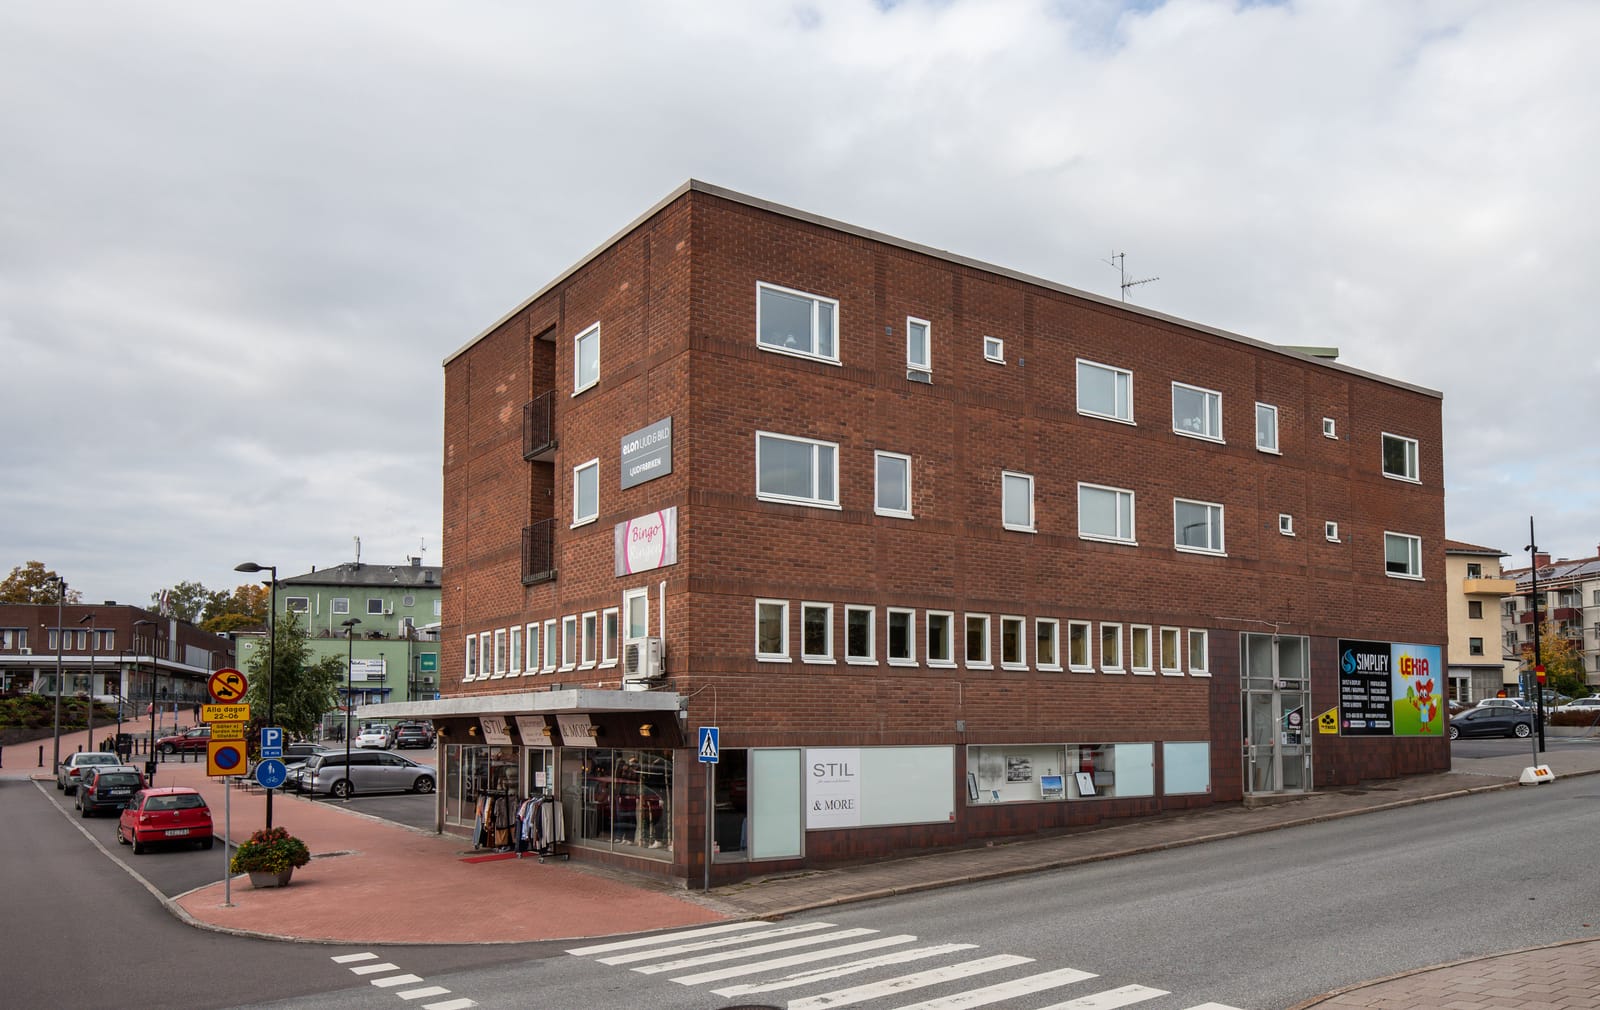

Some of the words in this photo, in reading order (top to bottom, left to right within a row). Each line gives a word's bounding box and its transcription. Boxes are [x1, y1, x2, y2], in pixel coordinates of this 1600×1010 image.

[622, 440, 639, 454] elon
[657, 427, 670, 441] BILD
[632, 524, 662, 543] Bingo
[1356, 653, 1388, 671] SIMPLIFY
[267, 730, 279, 746] P
[813, 763, 854, 777] STIL
[813, 800, 822, 811] &
[824, 799, 854, 810] MORE
